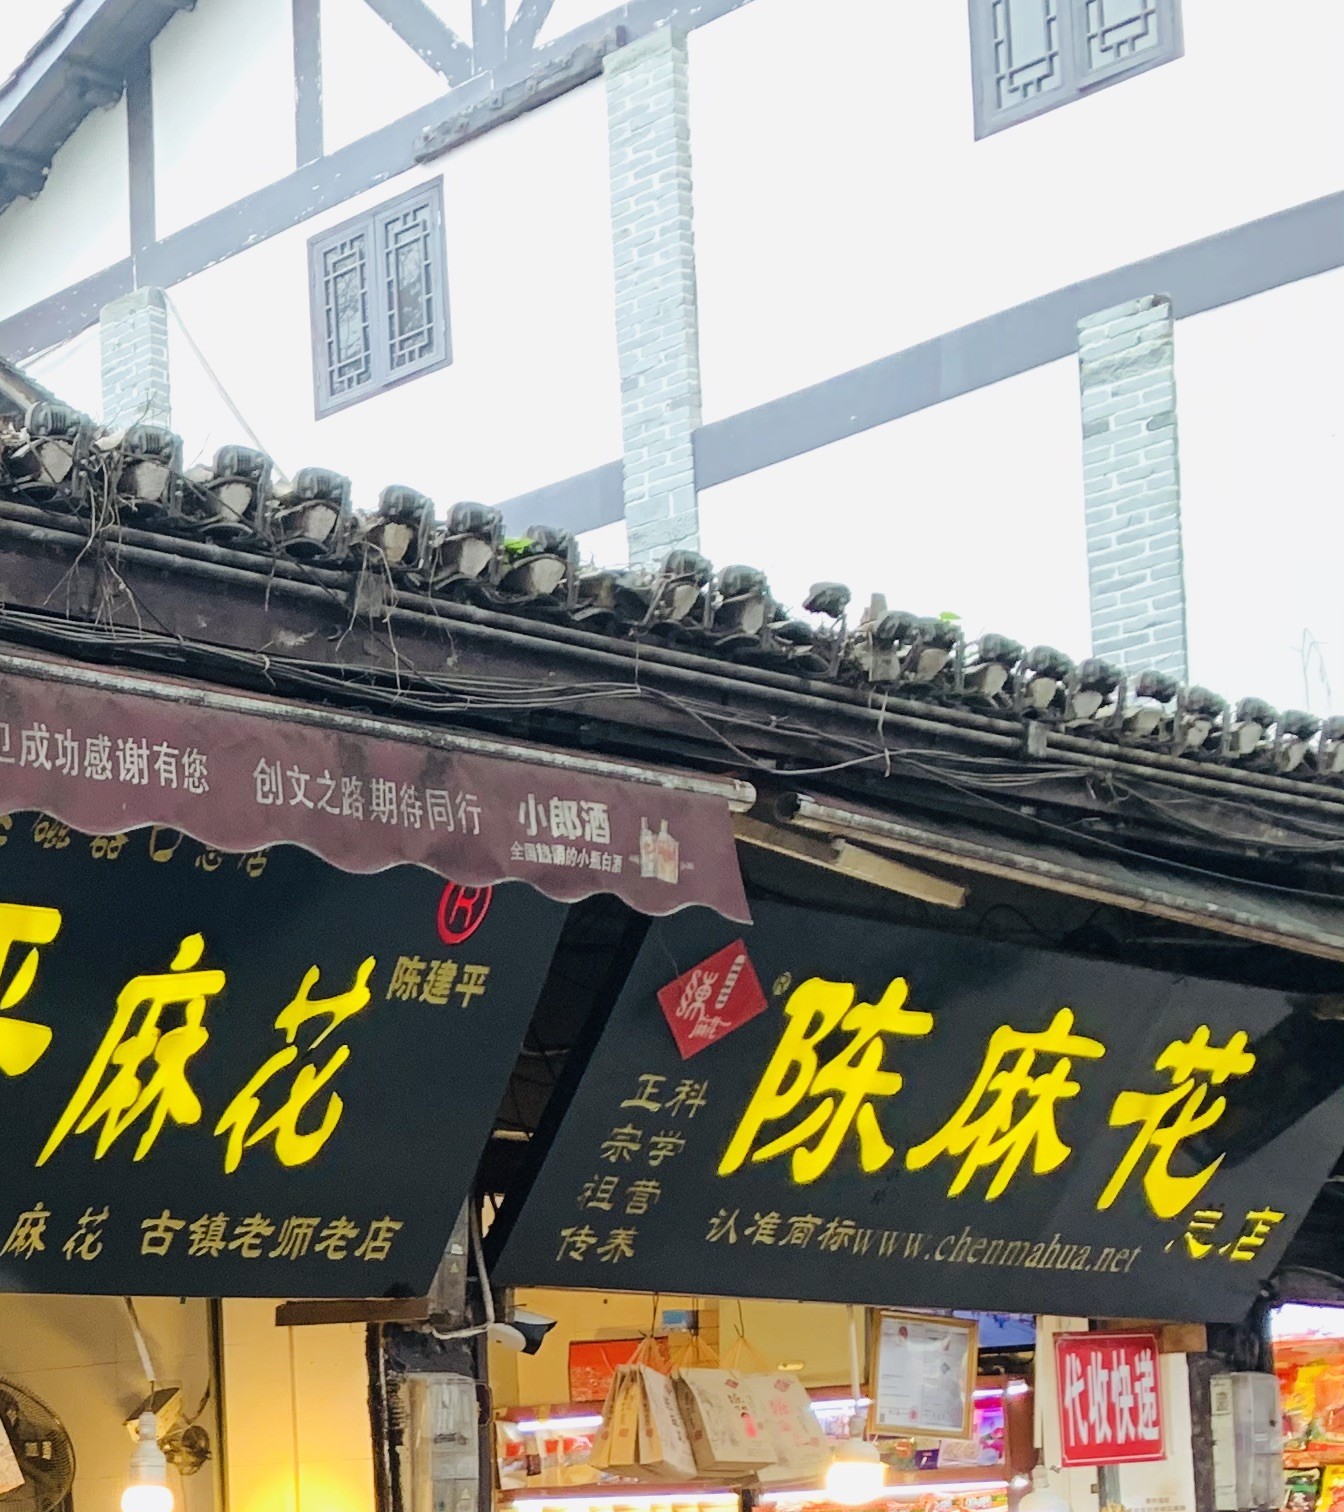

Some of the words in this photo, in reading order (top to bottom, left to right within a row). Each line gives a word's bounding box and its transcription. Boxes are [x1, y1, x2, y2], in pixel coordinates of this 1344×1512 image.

[253, 757, 483, 836] 创文之路期待同行
[518, 793, 611, 844] 小郎酒
[387, 953, 490, 1010] 陈建平
[718, 976, 1257, 1220] 陈麻花
[140, 1208, 404, 1262] 古镇老师老店
[851, 1222, 1142, 1275] www.chenmahua.net
[1064, 1348, 1160, 1448] 代收快递
